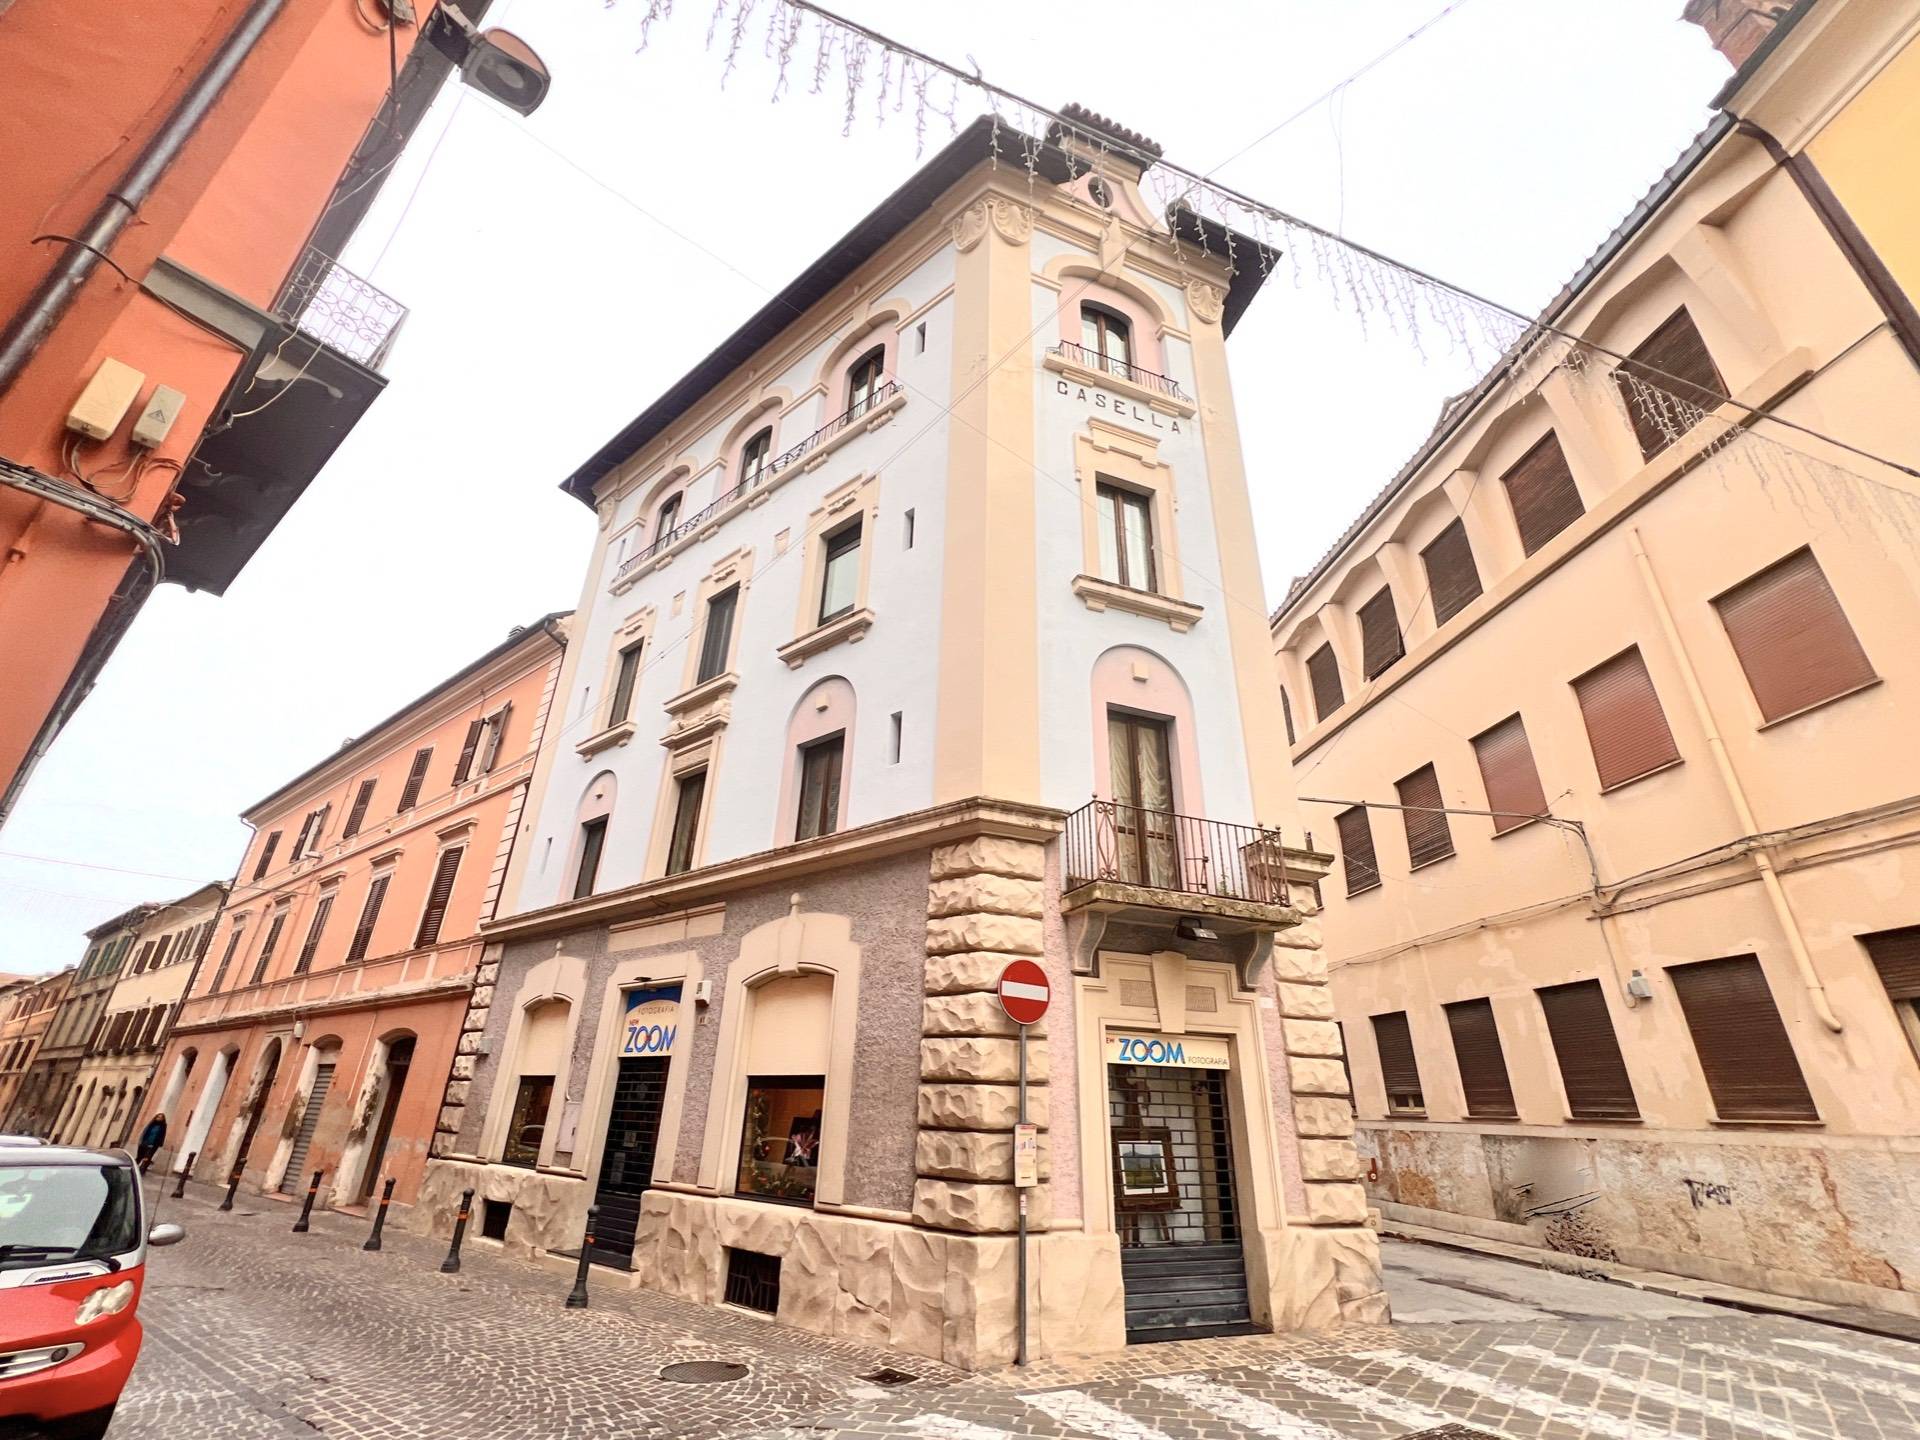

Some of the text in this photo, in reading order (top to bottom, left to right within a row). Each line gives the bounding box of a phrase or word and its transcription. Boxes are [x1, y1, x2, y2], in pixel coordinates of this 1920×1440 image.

[1057, 380, 1181, 434] CASELLA
[639, 1006, 674, 1015] FOTOGRAFIA
[624, 1025, 677, 1052] ZOOM
[1118, 1038, 1185, 1064] ZOOM
[1188, 1056, 1228, 1065] FOTOGRAFIA
